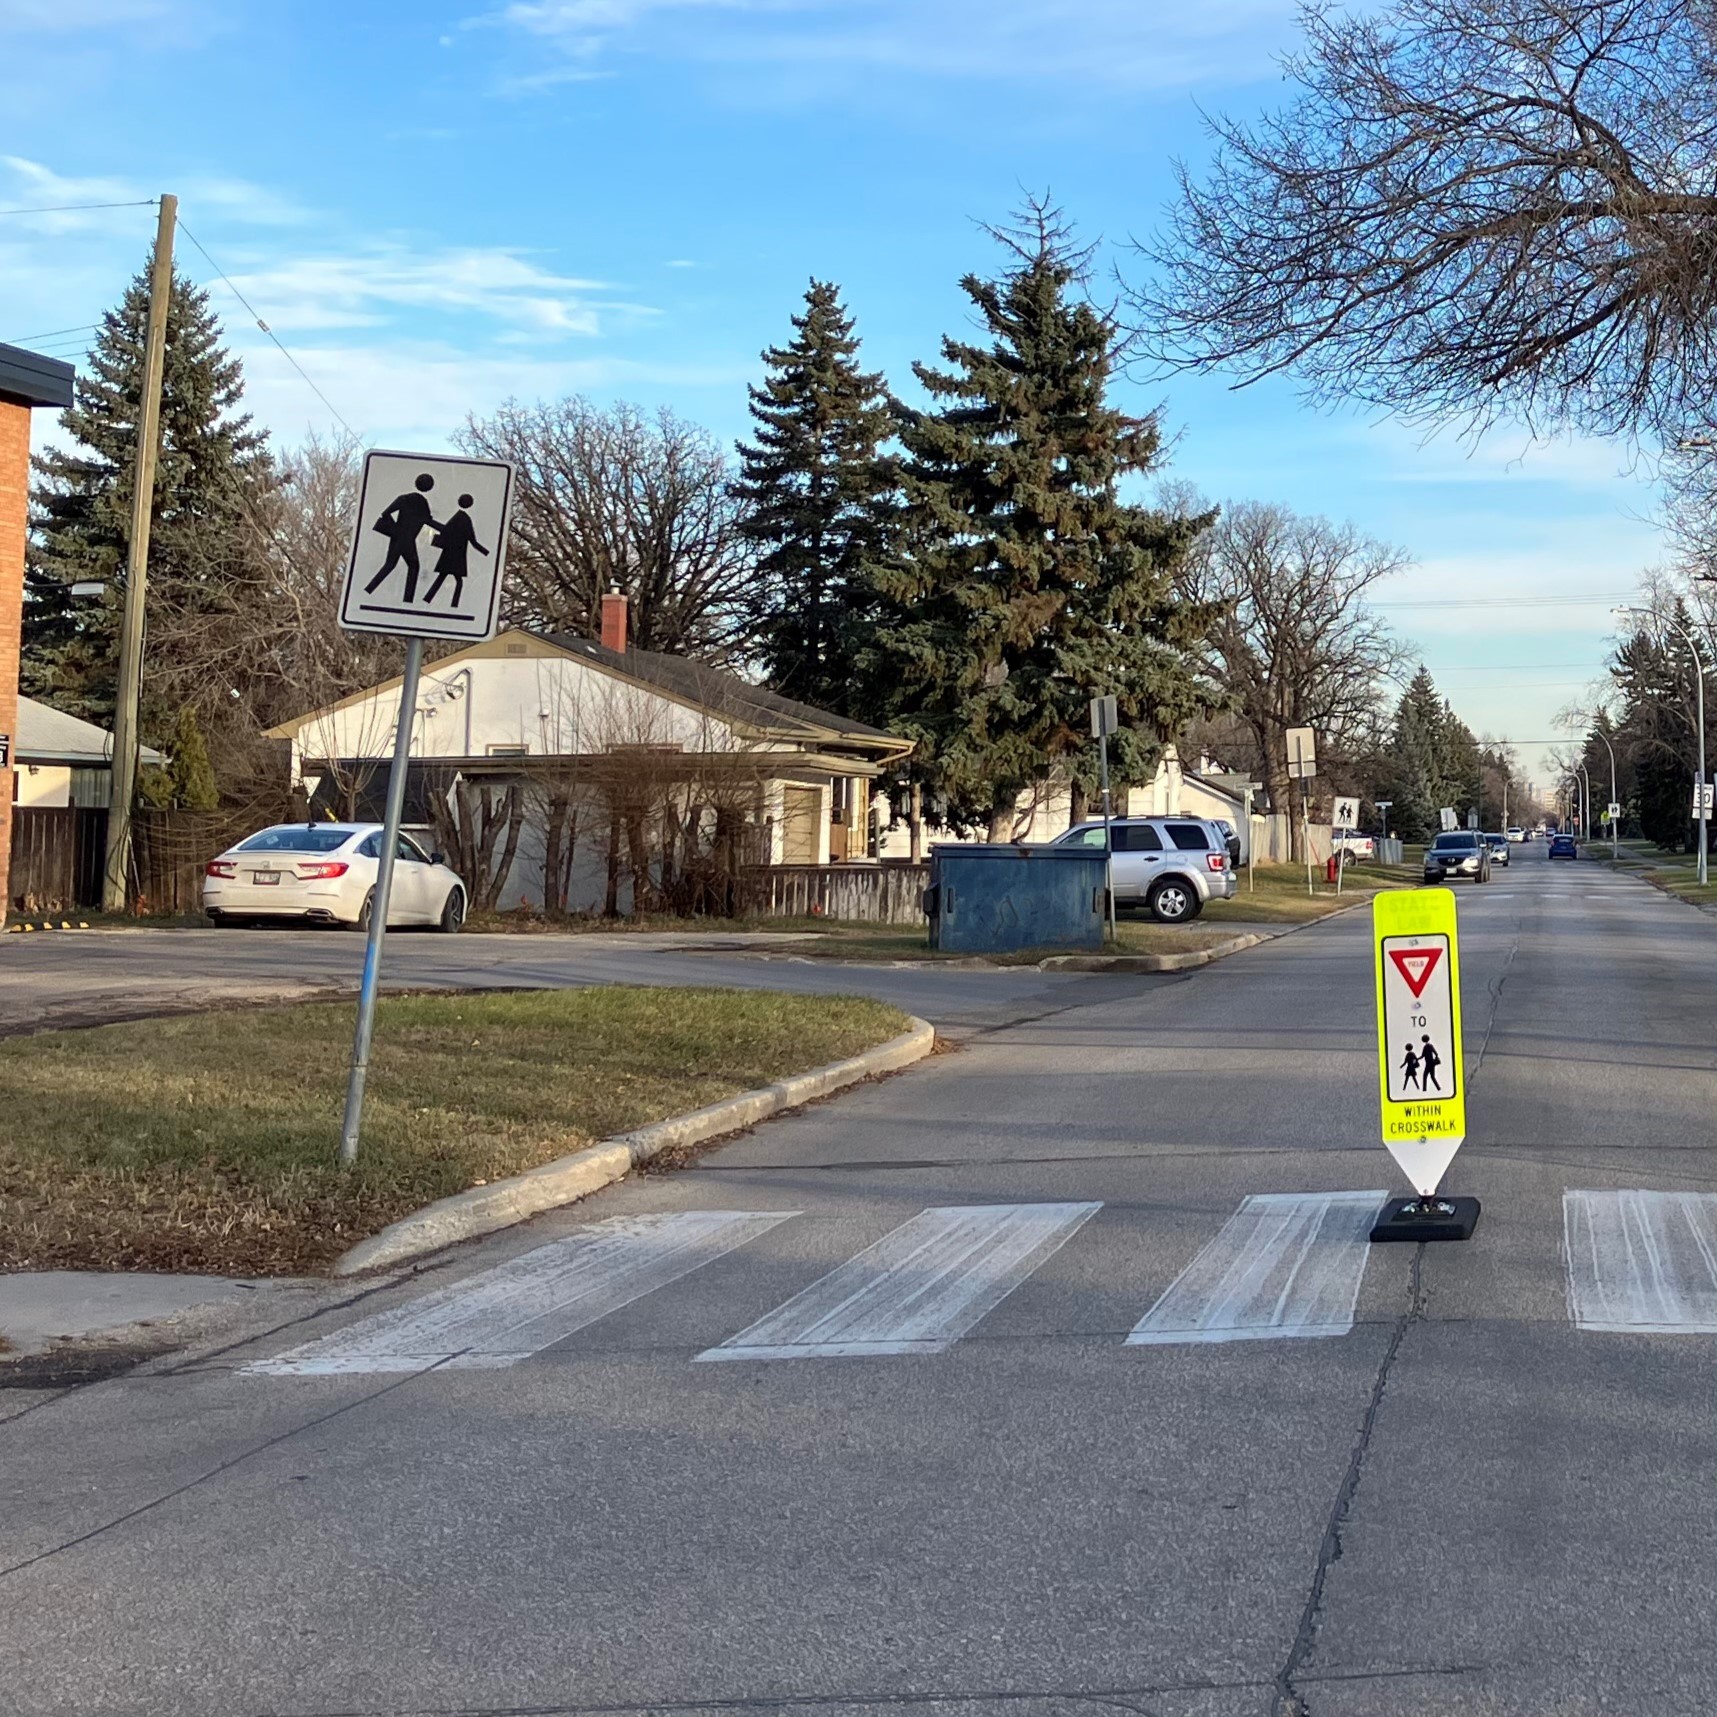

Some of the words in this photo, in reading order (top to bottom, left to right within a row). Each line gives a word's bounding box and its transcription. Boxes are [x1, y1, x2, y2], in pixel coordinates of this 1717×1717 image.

[1408, 960, 1425, 968] YIELD
[1410, 1015, 1427, 1028] TO
[1404, 1104, 1442, 1118] WITHIN
[1390, 1119, 1456, 1135] CROSSWALK
